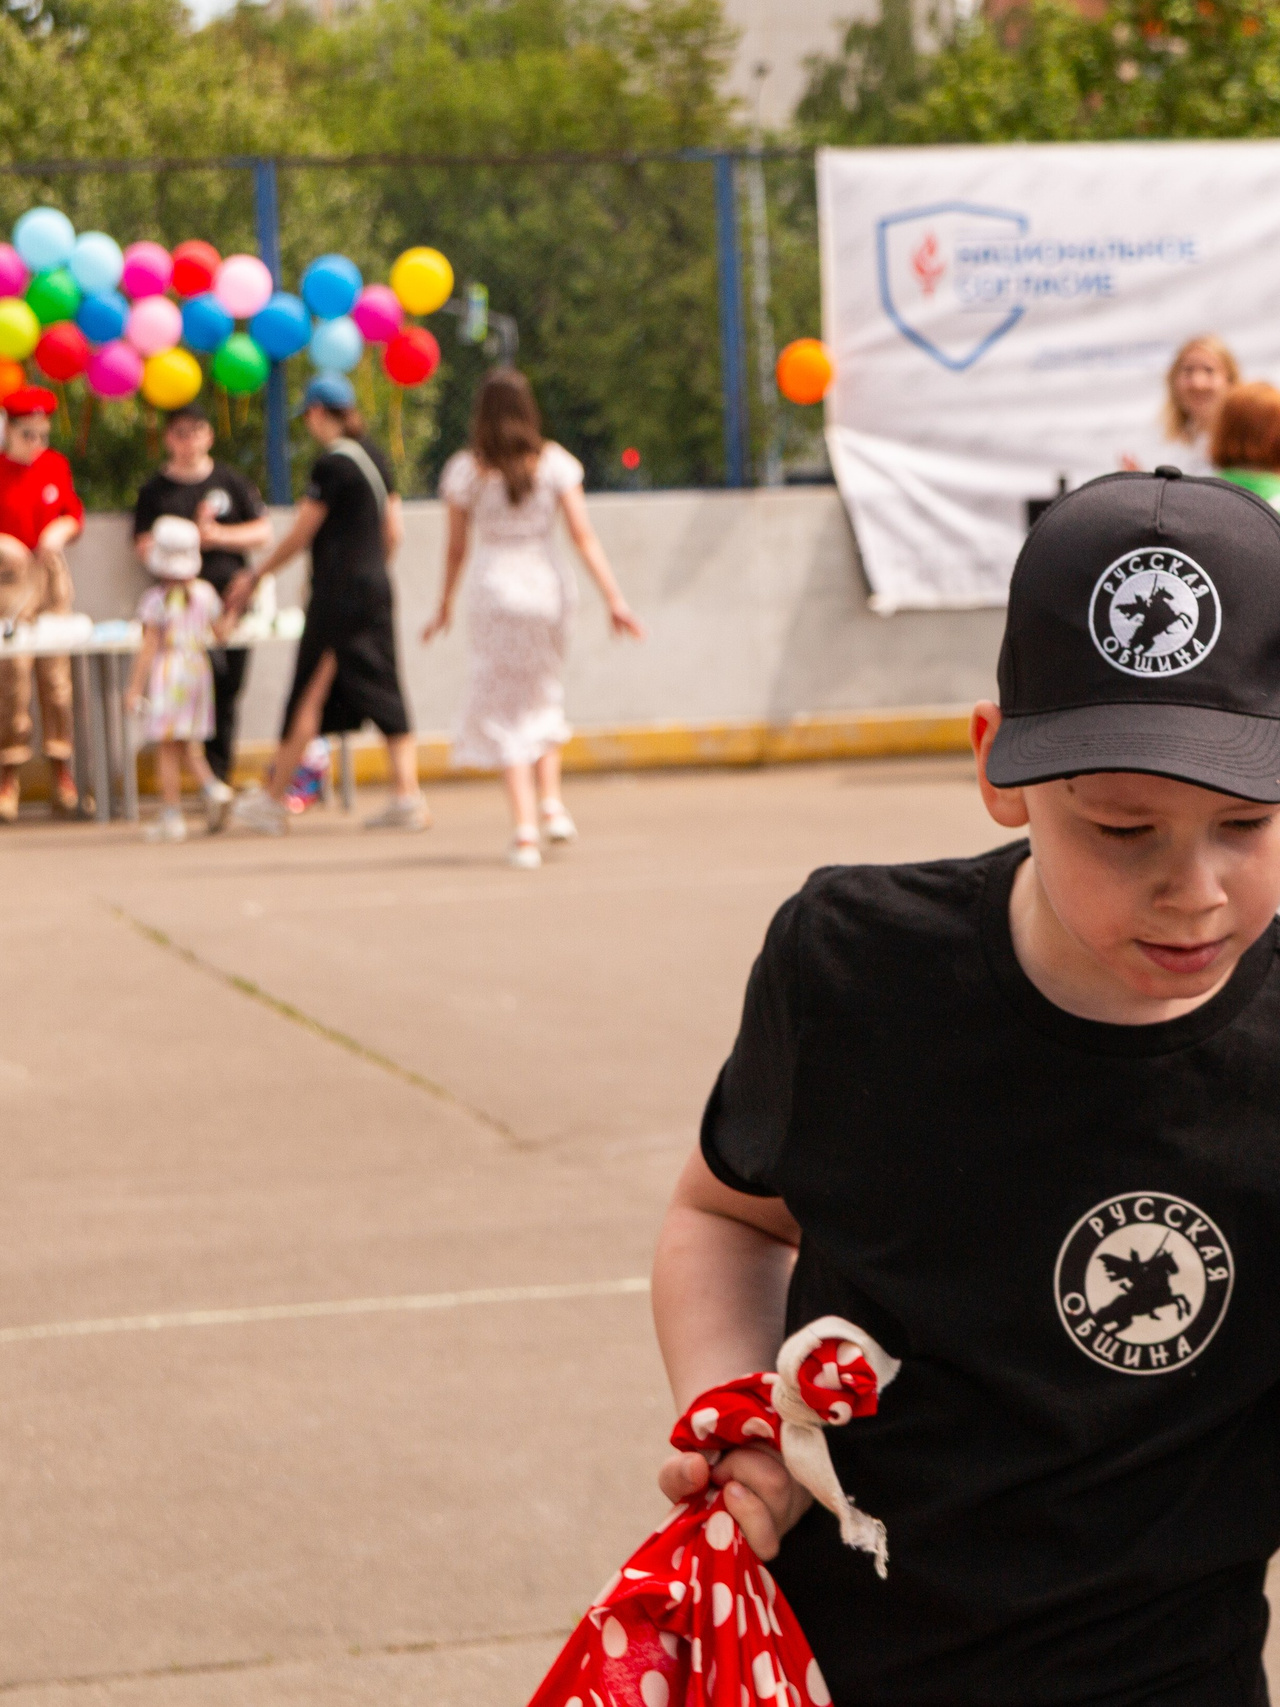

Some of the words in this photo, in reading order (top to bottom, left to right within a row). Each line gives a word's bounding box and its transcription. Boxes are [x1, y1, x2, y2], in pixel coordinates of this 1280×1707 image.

[1103, 554, 1209, 598] РУССКАЯ
[1103, 637, 1206, 672] ОБЩИНА
[1088, 1198, 1229, 1282] РУССКАЯ
[1063, 1292, 1192, 1367] ОБЩИНА
